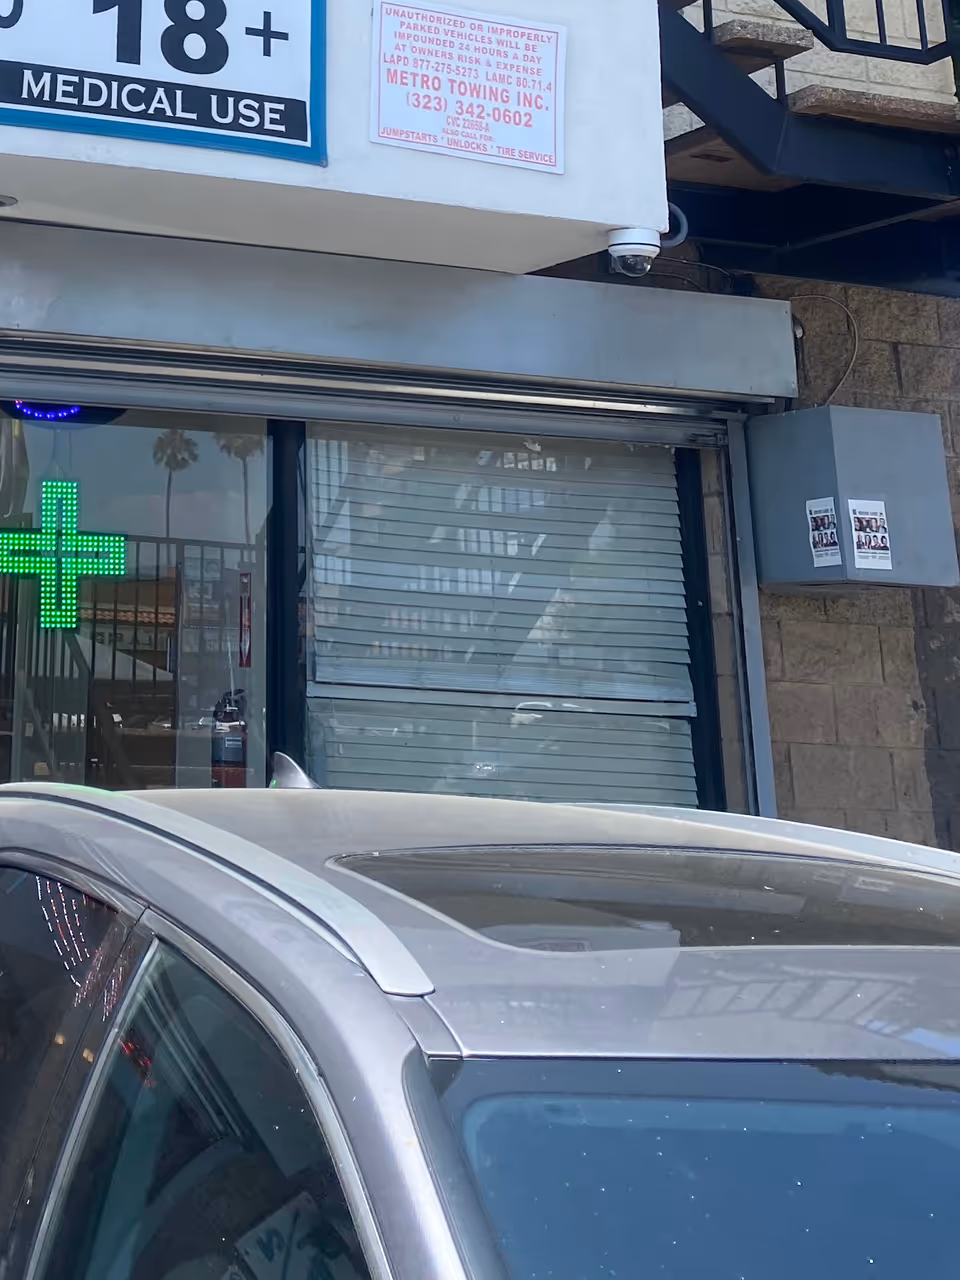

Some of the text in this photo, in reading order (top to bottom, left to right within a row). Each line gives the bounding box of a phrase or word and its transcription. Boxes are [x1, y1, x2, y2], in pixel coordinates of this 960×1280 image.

[385, 8, 553, 44] UNAUTHORIZED OR IMPROPERLY
[400, 20, 538, 52] PARKED VEHICLES WILL BE
[394, 31, 542, 64] IMPOUNDED 24 HOURS A DAY
[395, 43, 407, 52] AT
[411, 45, 454, 61] OWNERS
[457, 54, 481, 66] RISK
[496, 61, 543, 77] EXPENSE
[383, 52, 409, 67] LAPD
[486, 71, 512, 85] LAMC
[20, 68, 288, 133] MEDICAL USE
[386, 68, 549, 112] METRO TOWING INC.
[406, 92, 533, 128] (323) 342-0602
[381, 127, 554, 164] JUMPSTARTS UNLOCKS TIRE SERVICE
